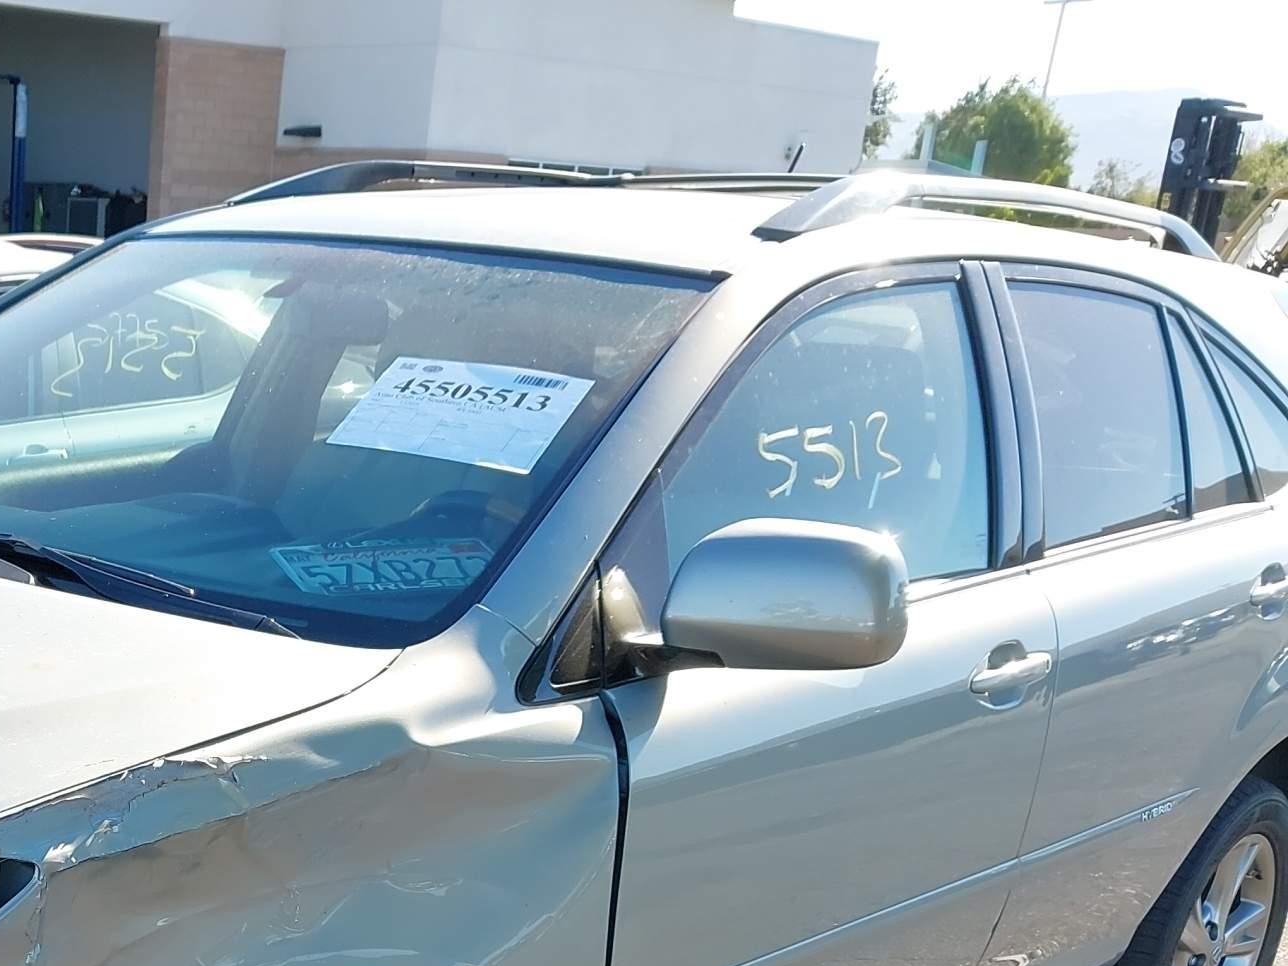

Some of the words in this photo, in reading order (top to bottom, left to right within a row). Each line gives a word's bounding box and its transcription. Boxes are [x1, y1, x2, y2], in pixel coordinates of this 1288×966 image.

[393, 376, 552, 412] 45505513
[758, 410, 902, 500] 5513
[1142, 802, 1173, 822] HYBRID
